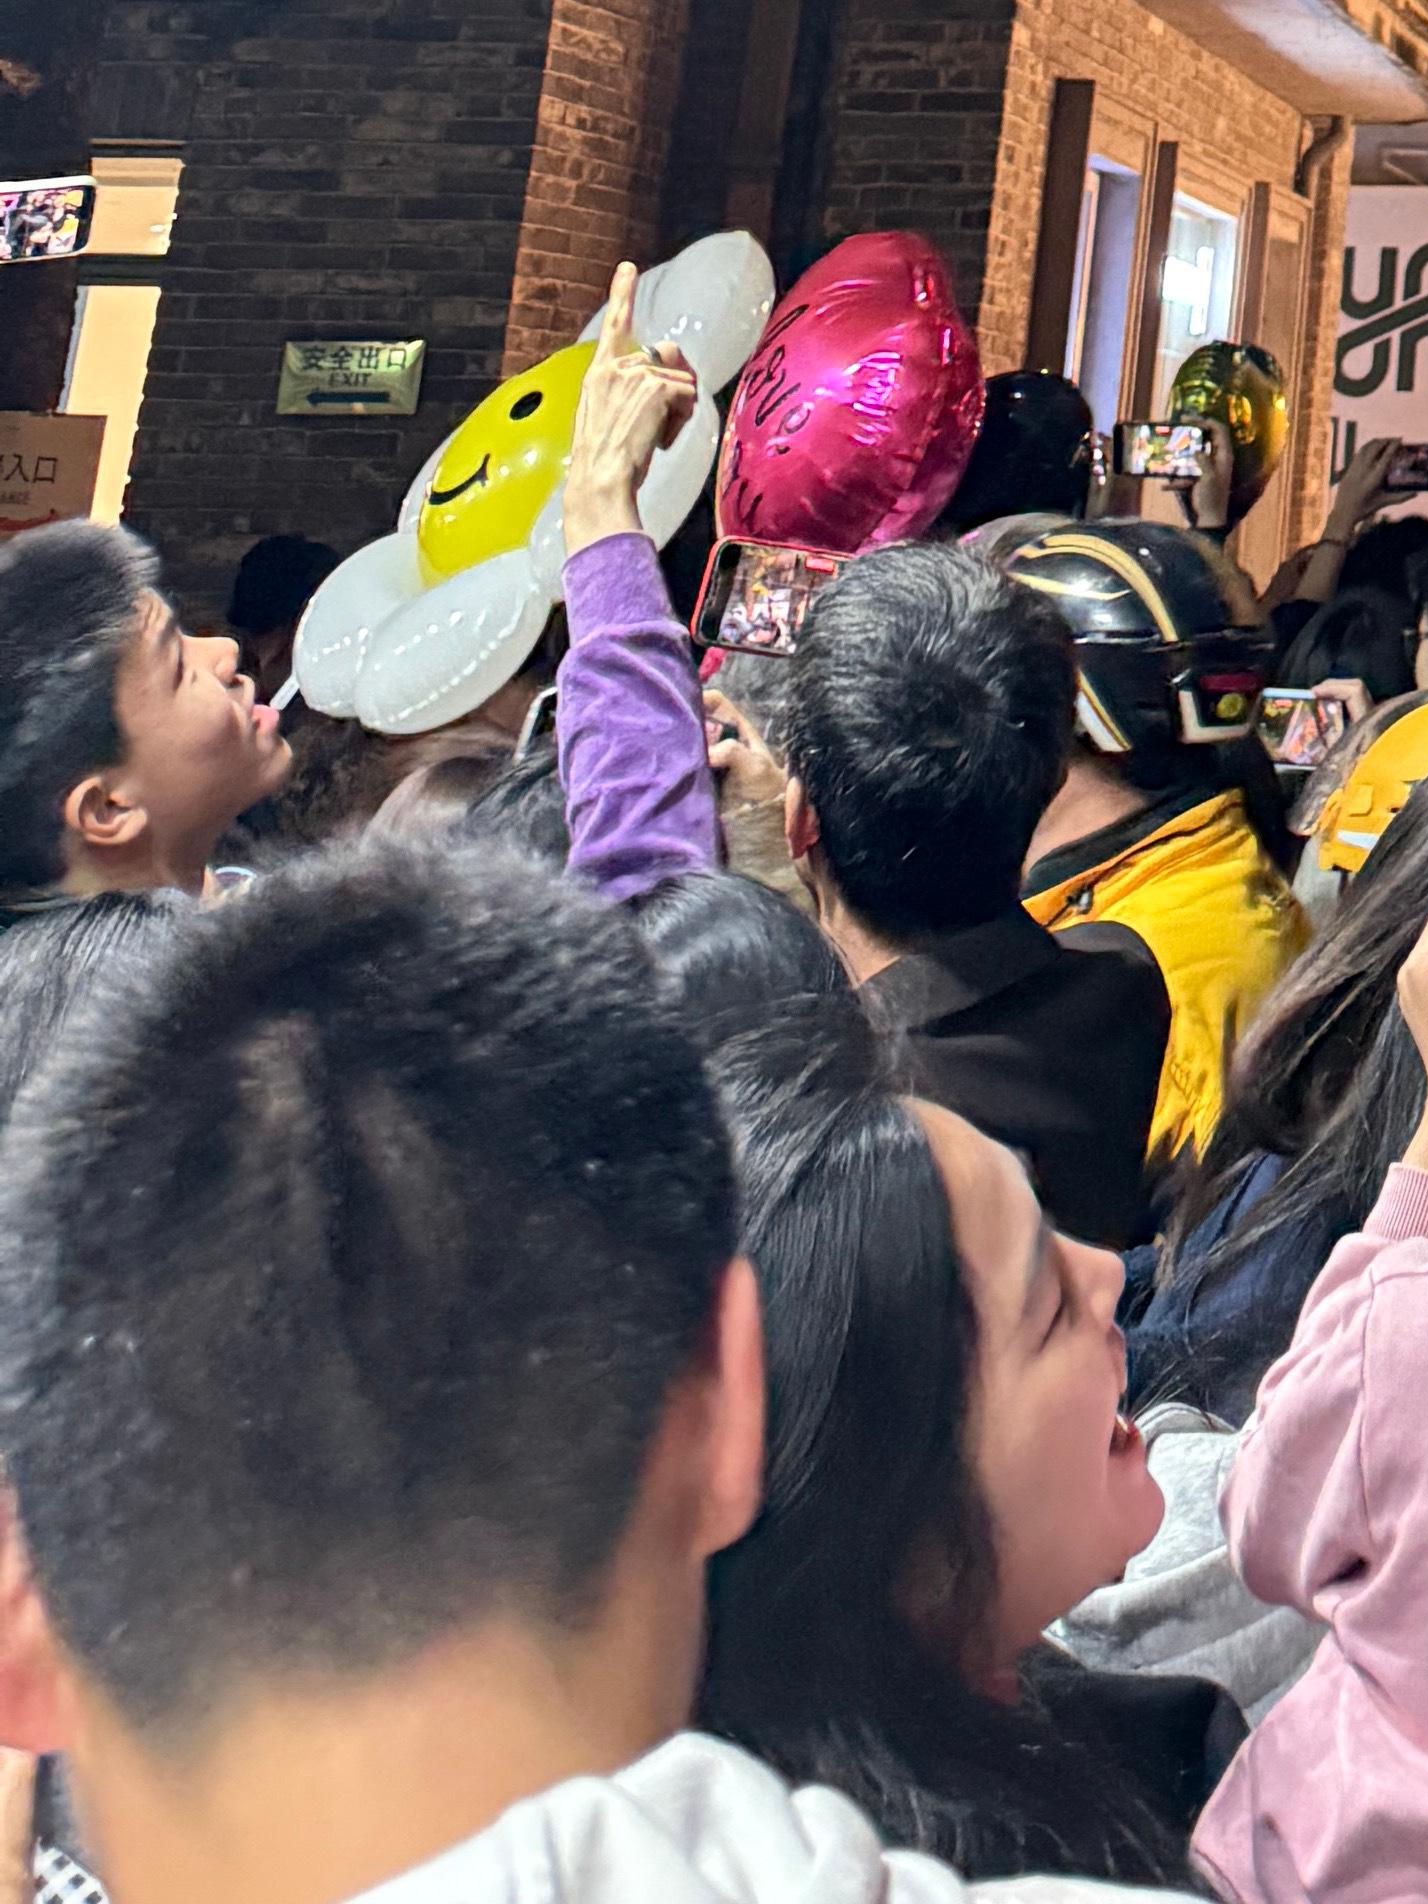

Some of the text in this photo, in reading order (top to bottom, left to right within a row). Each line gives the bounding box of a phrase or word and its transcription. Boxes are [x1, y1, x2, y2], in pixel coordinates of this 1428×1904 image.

[303, 346, 407, 370] 安全出口
[329, 372, 372, 386] EXIT
[0, 454, 58, 483] 入口
